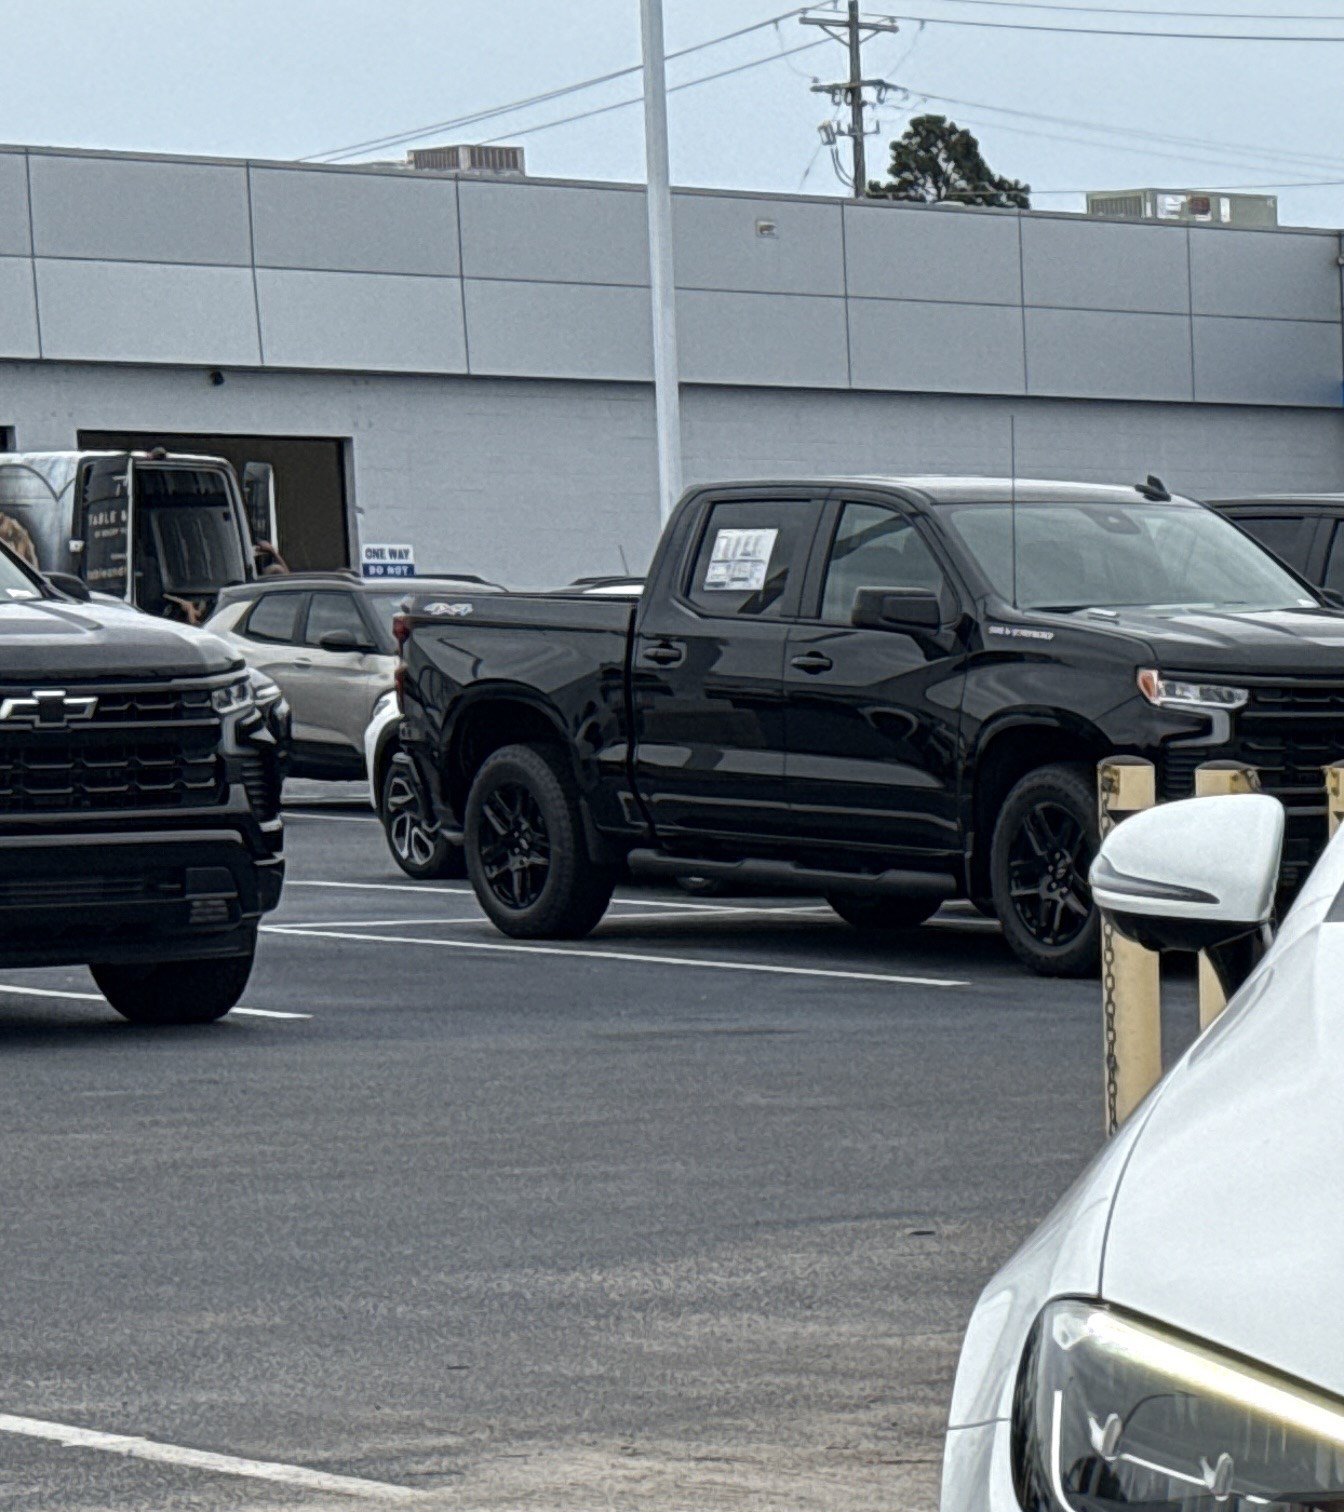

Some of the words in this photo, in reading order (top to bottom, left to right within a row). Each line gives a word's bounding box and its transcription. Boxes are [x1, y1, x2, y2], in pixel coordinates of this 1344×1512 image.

[365, 547, 386, 560] ONE
[388, 547, 410, 560] WAY
[368, 565, 384, 576] DO
[386, 565, 409, 576] NOT
